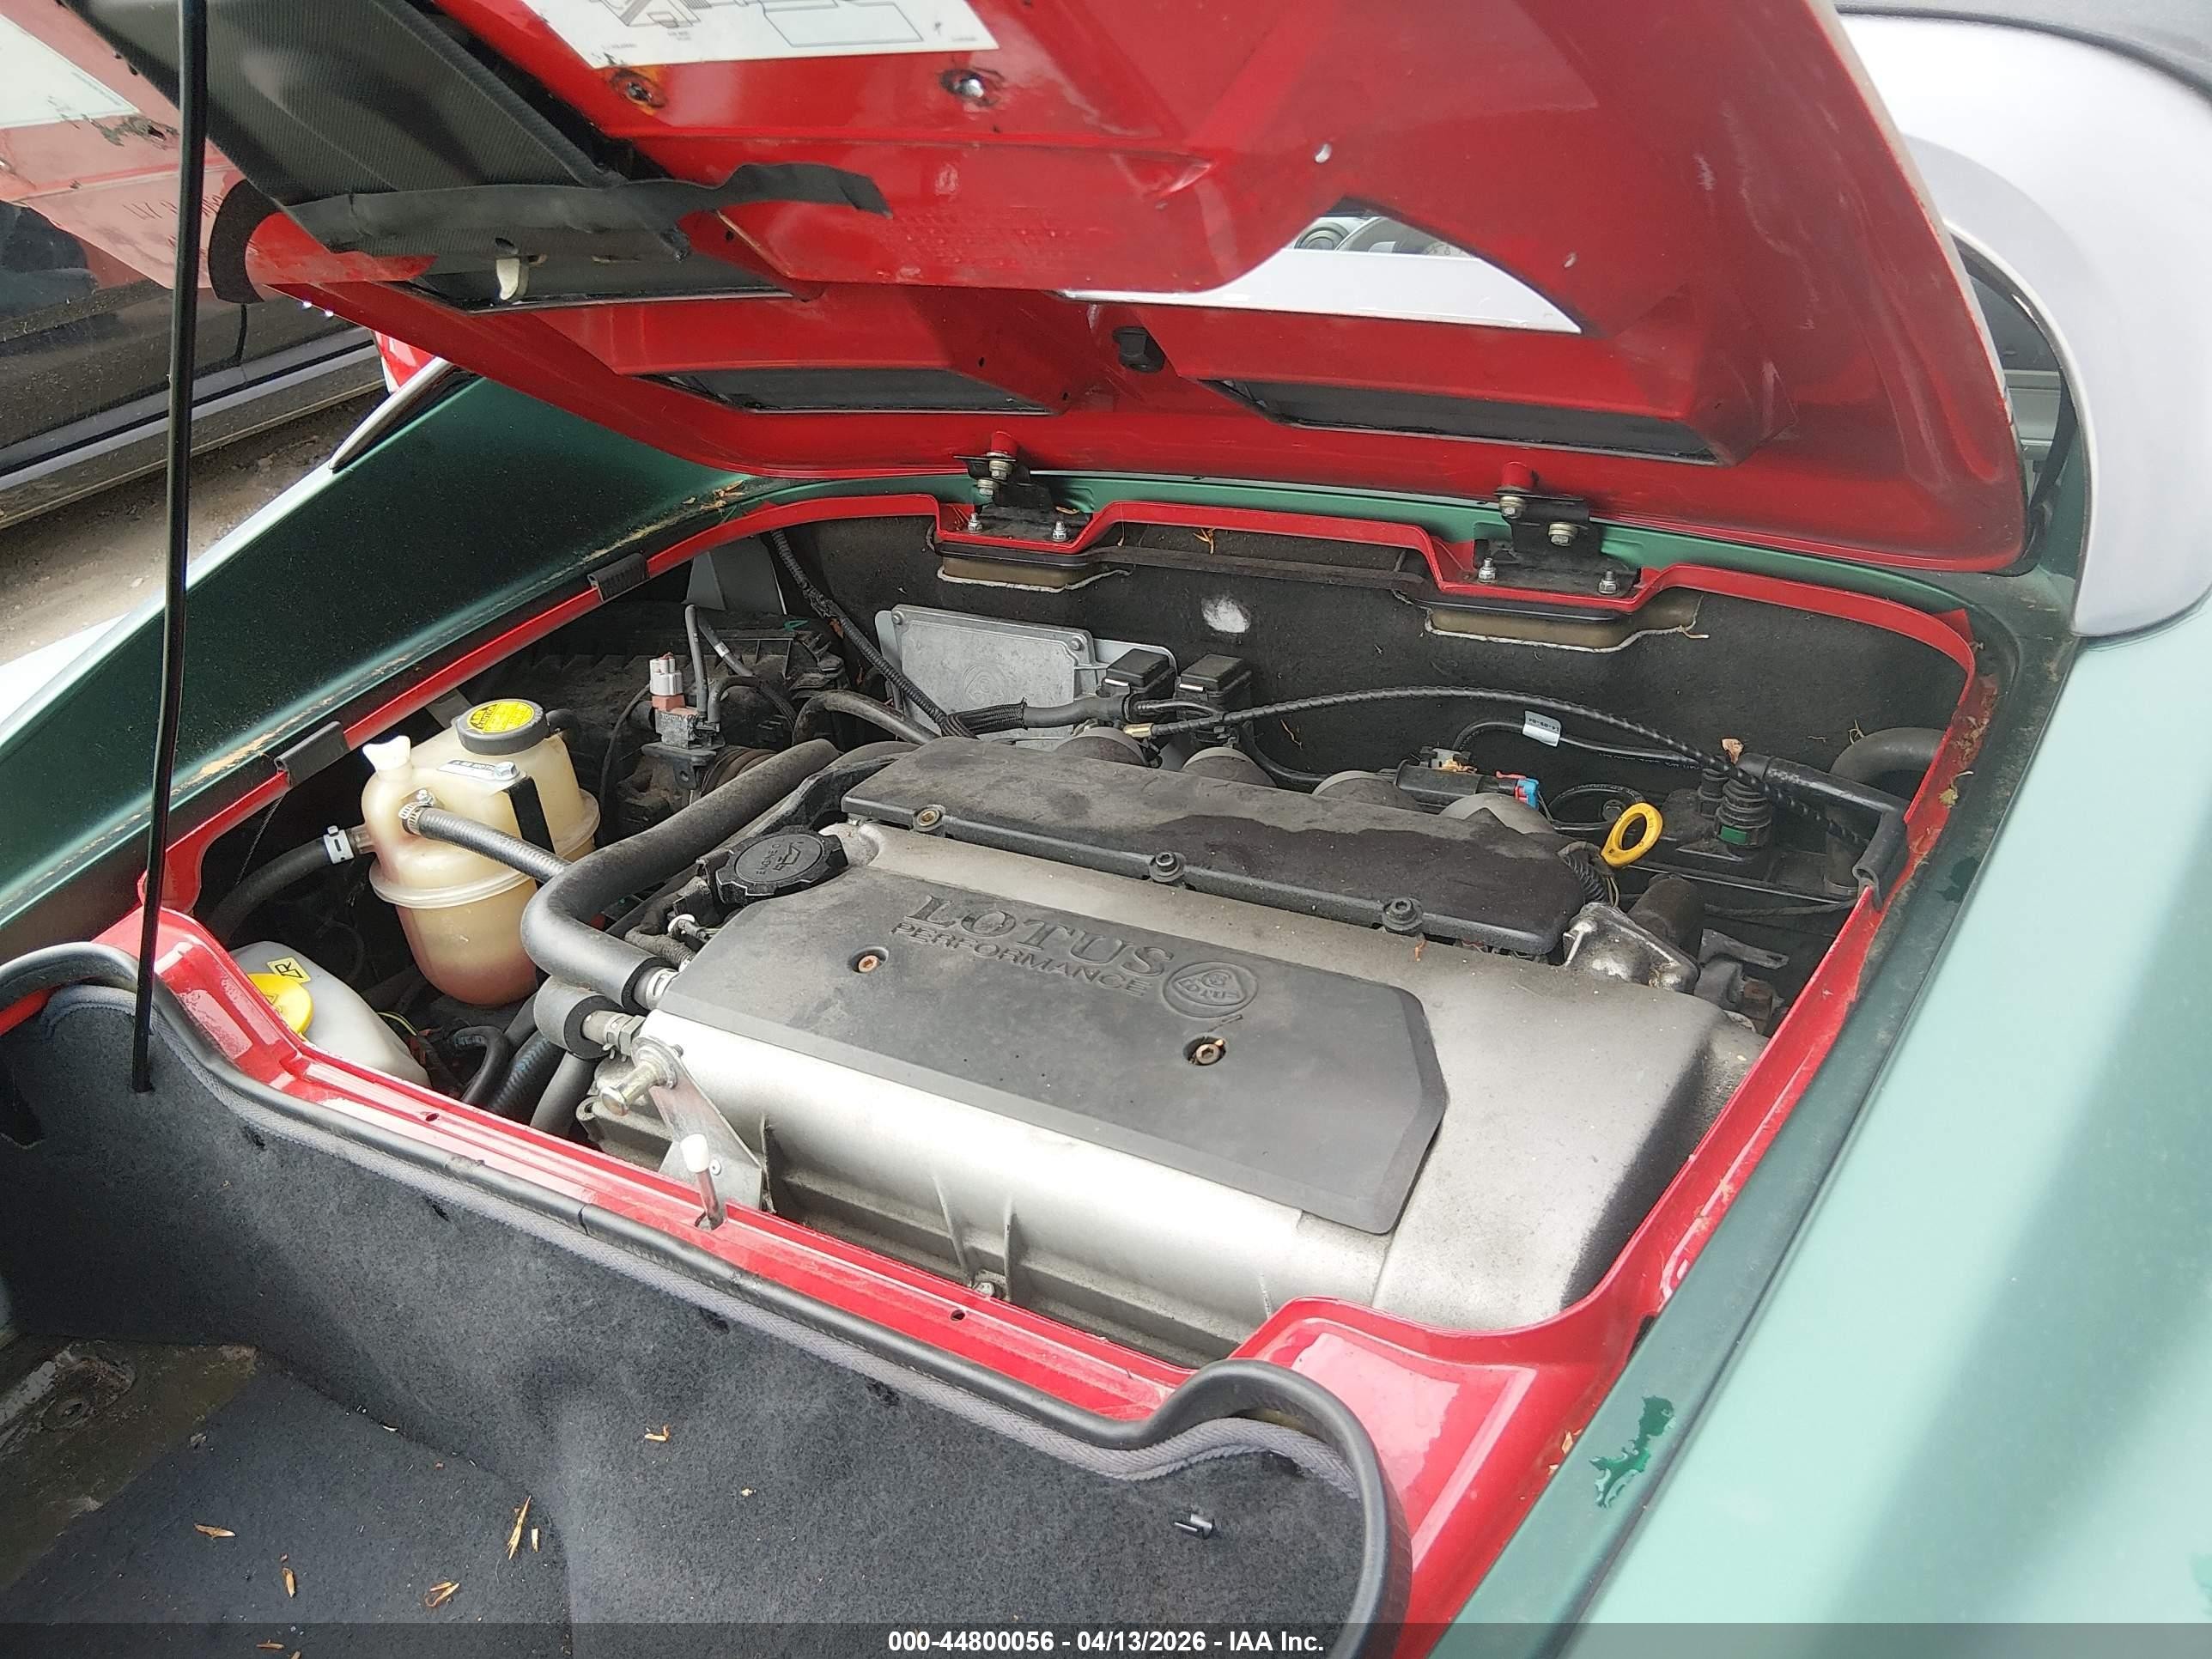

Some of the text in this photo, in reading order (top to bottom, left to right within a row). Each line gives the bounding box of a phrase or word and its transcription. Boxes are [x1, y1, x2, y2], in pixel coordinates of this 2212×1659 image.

[660, 713, 683, 722] TOYOTA
[889, 921, 1152, 996] PERFORMANCE
[904, 895, 1174, 976] LOTUS
